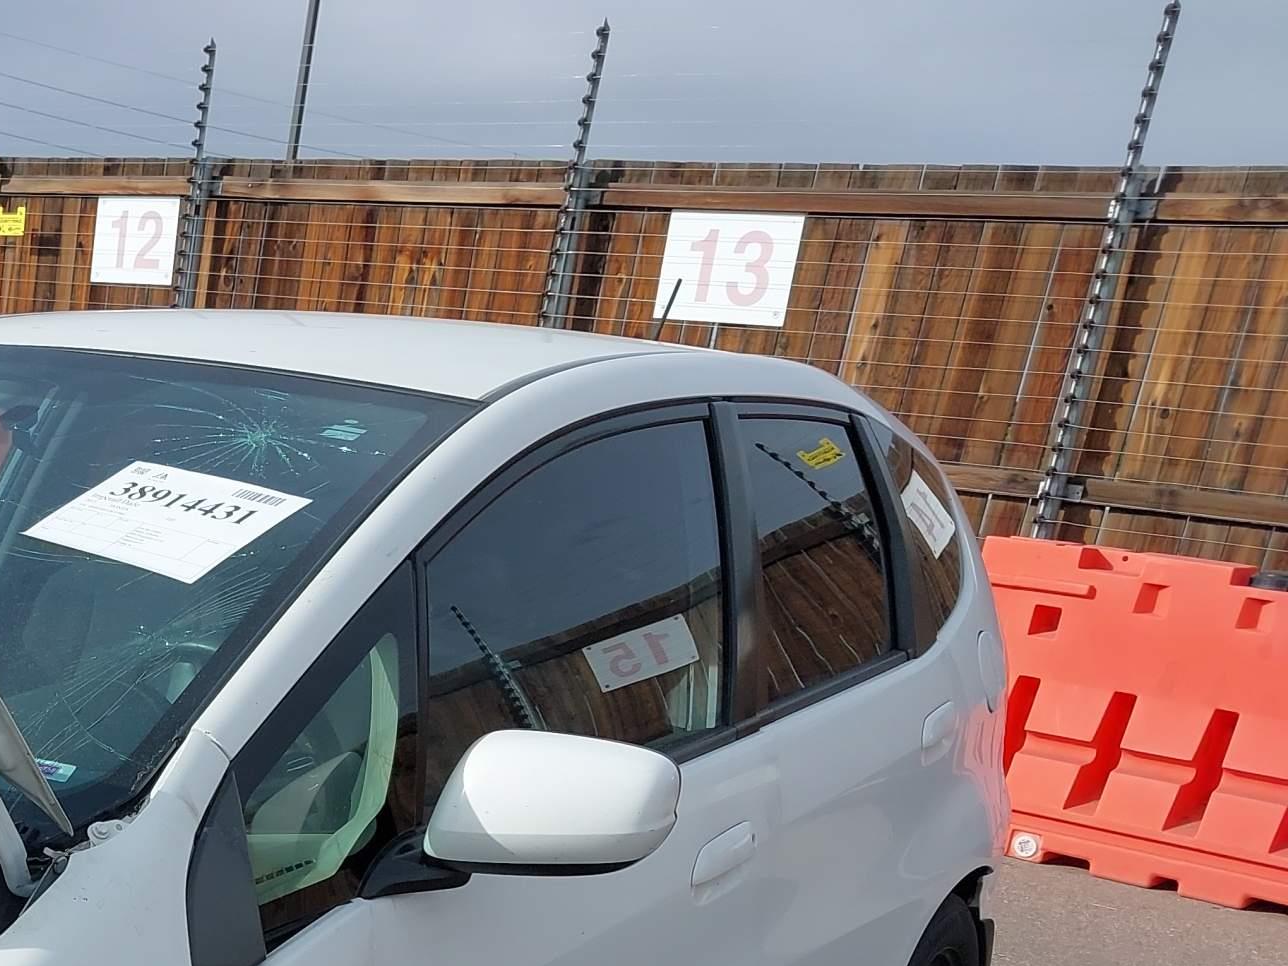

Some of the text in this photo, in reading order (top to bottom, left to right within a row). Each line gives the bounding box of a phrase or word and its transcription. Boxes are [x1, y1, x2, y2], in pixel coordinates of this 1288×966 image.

[111, 210, 164, 270] 12
[690, 229, 774, 306] 13
[110, 481, 258, 525] 38914431
